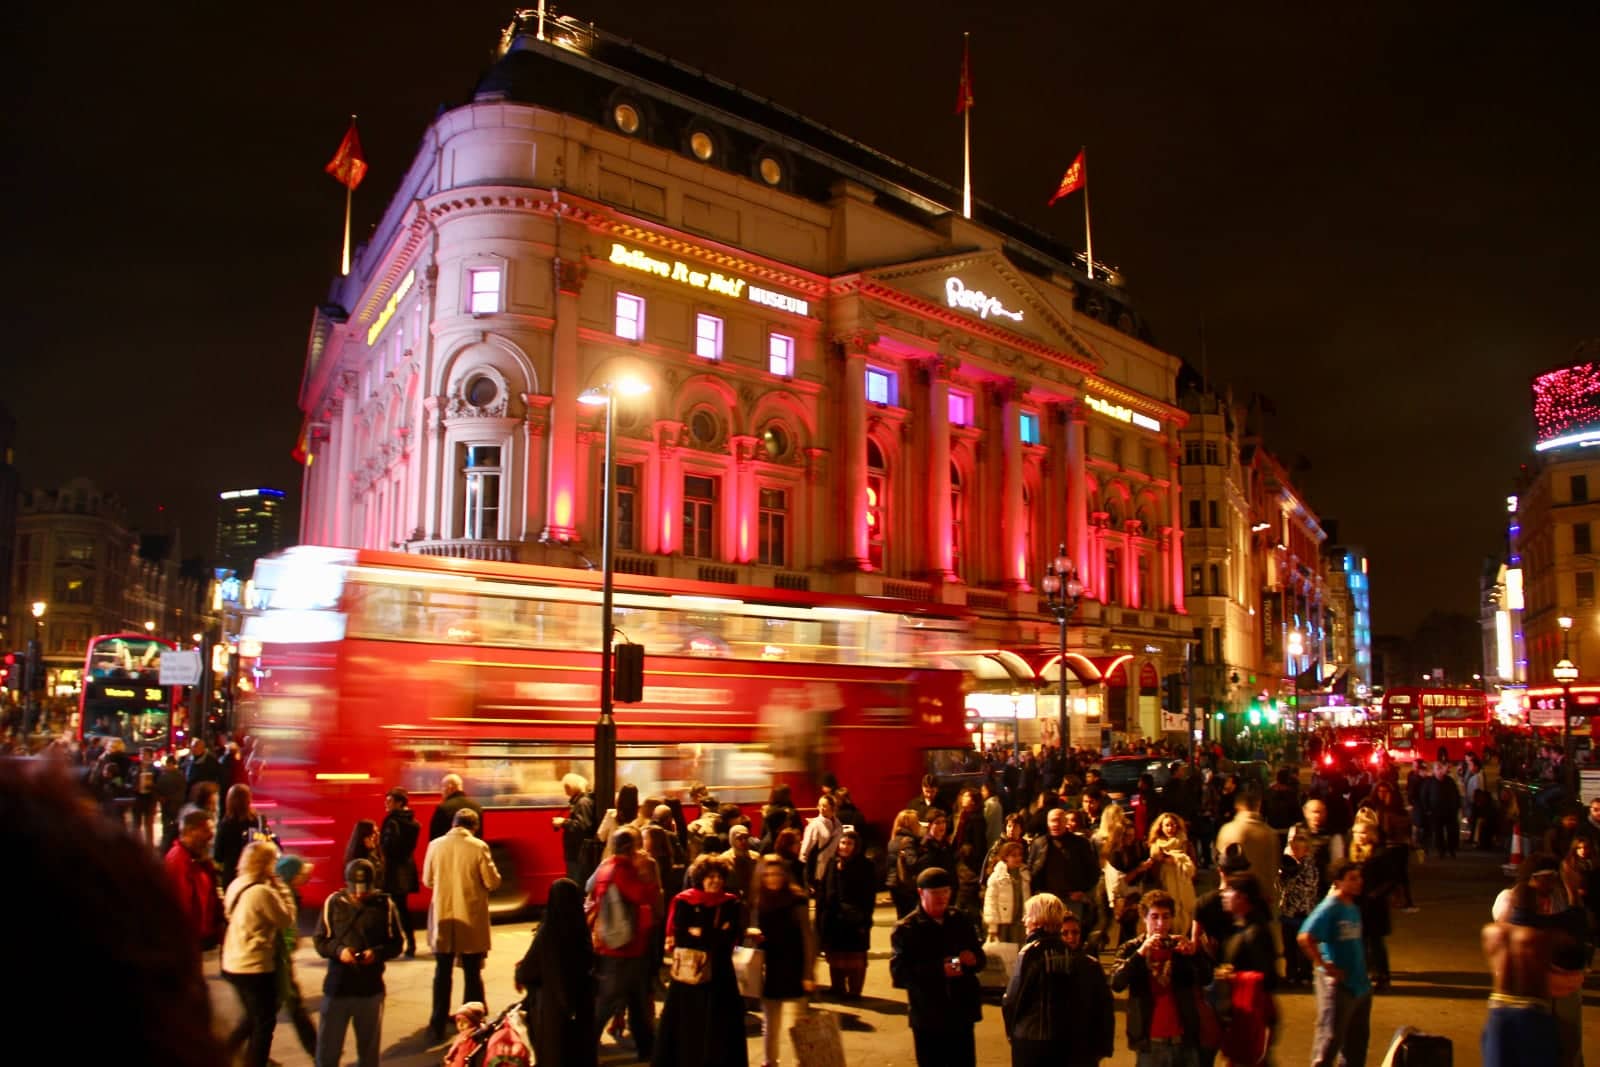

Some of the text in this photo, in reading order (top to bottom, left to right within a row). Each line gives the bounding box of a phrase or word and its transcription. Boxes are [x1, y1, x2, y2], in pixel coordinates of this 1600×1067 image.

[609, 243, 807, 315] Believe It or Not! MUSEUM
[946, 276, 1023, 321] Ripley's
